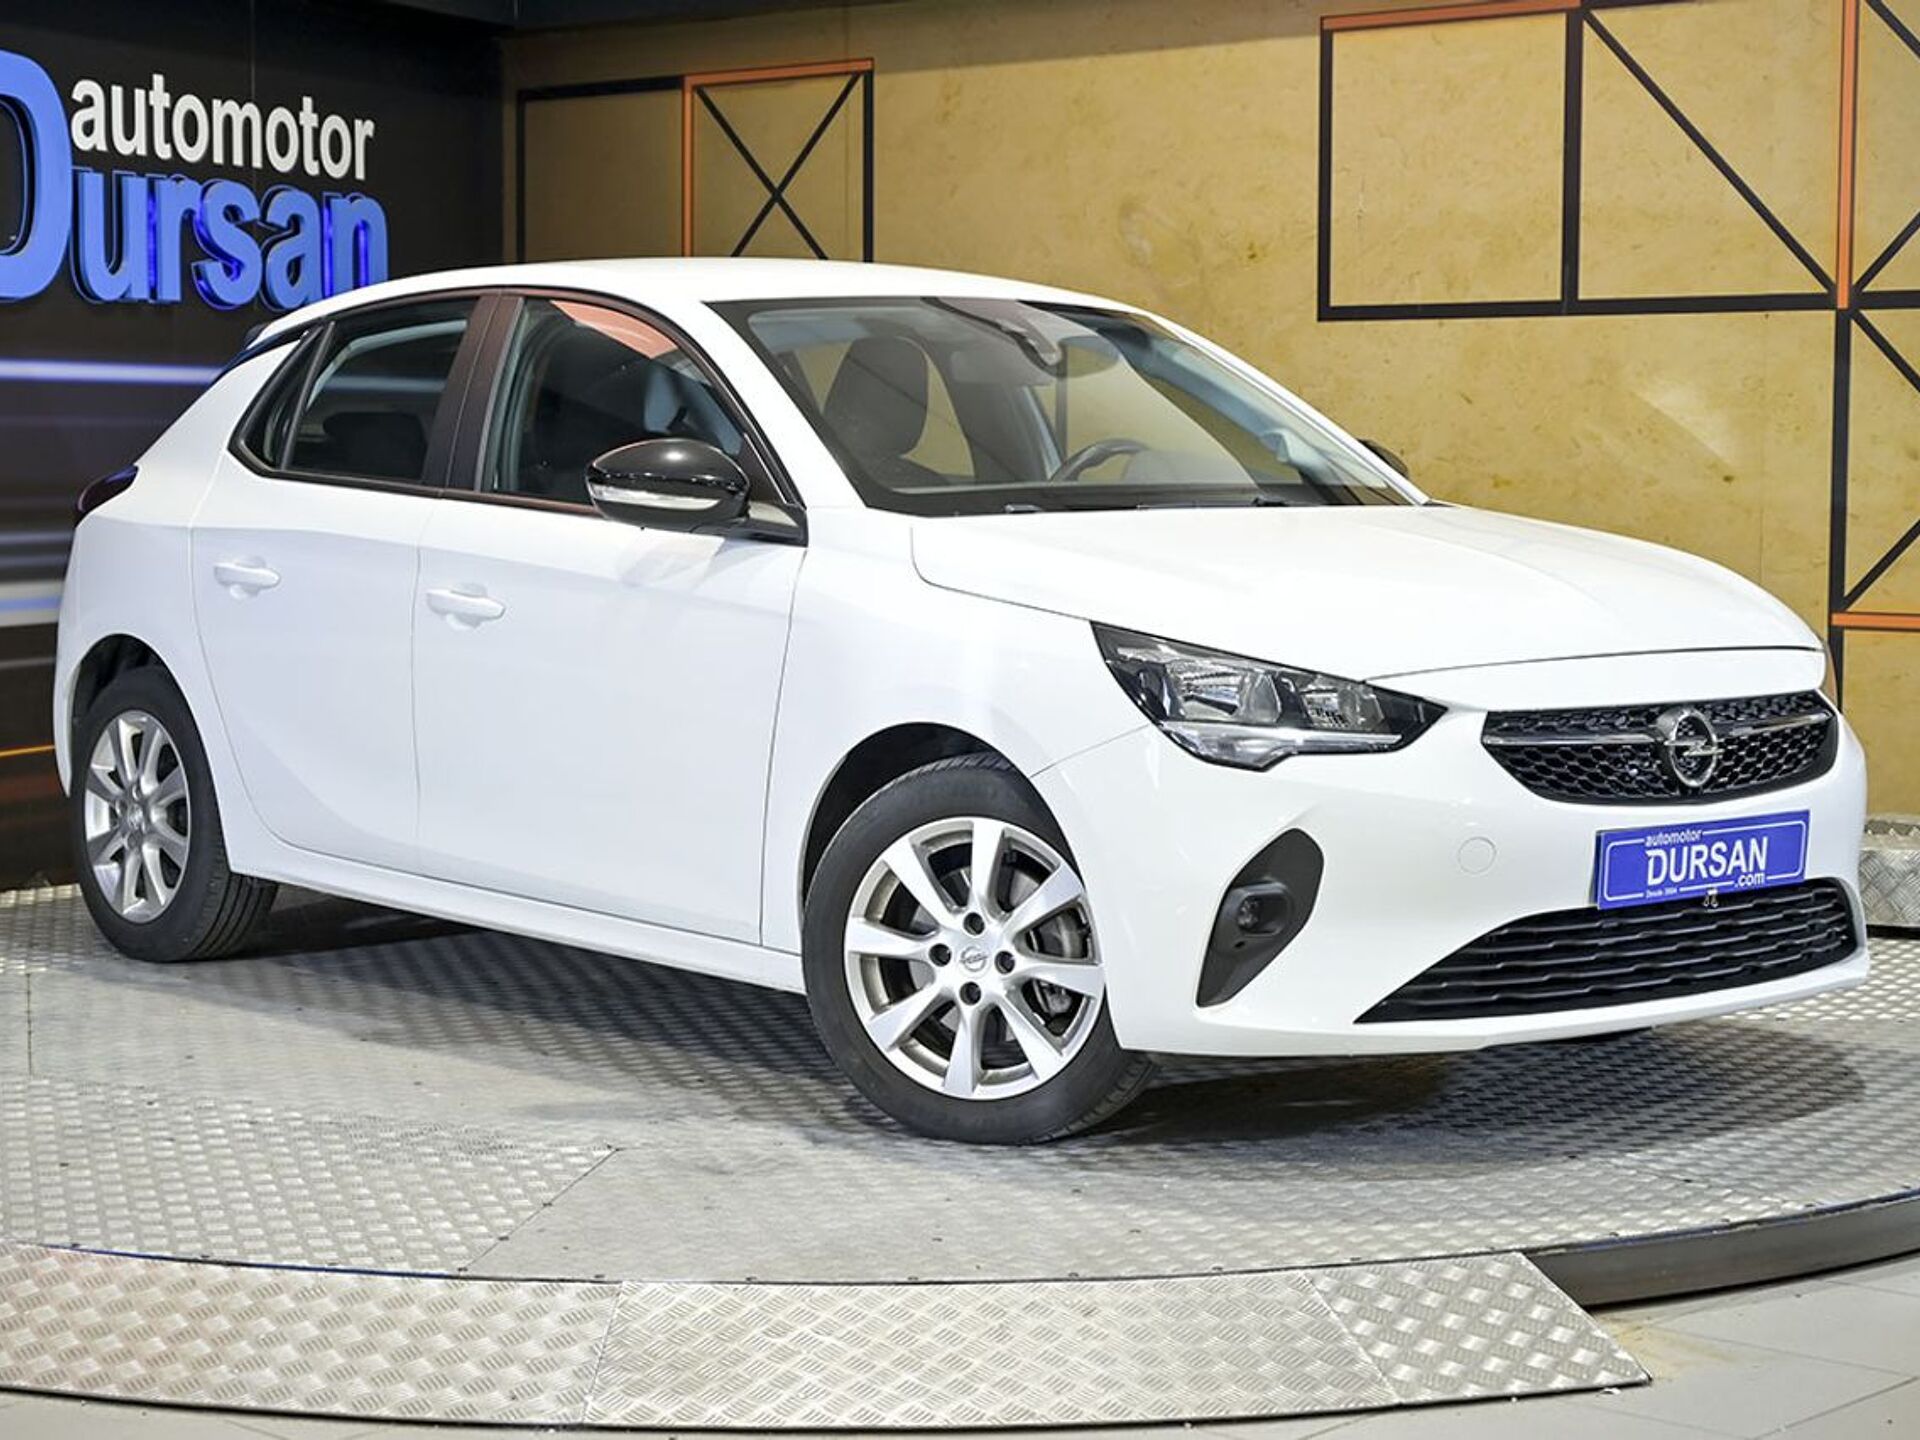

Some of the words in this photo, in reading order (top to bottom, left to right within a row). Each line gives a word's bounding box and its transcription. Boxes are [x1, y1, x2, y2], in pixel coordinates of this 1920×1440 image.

[71, 74, 375, 180] automotor
[1645, 829, 1702, 847] automotor
[1645, 836, 1768, 886] DURSAN
[1734, 873, 1766, 888] .com
